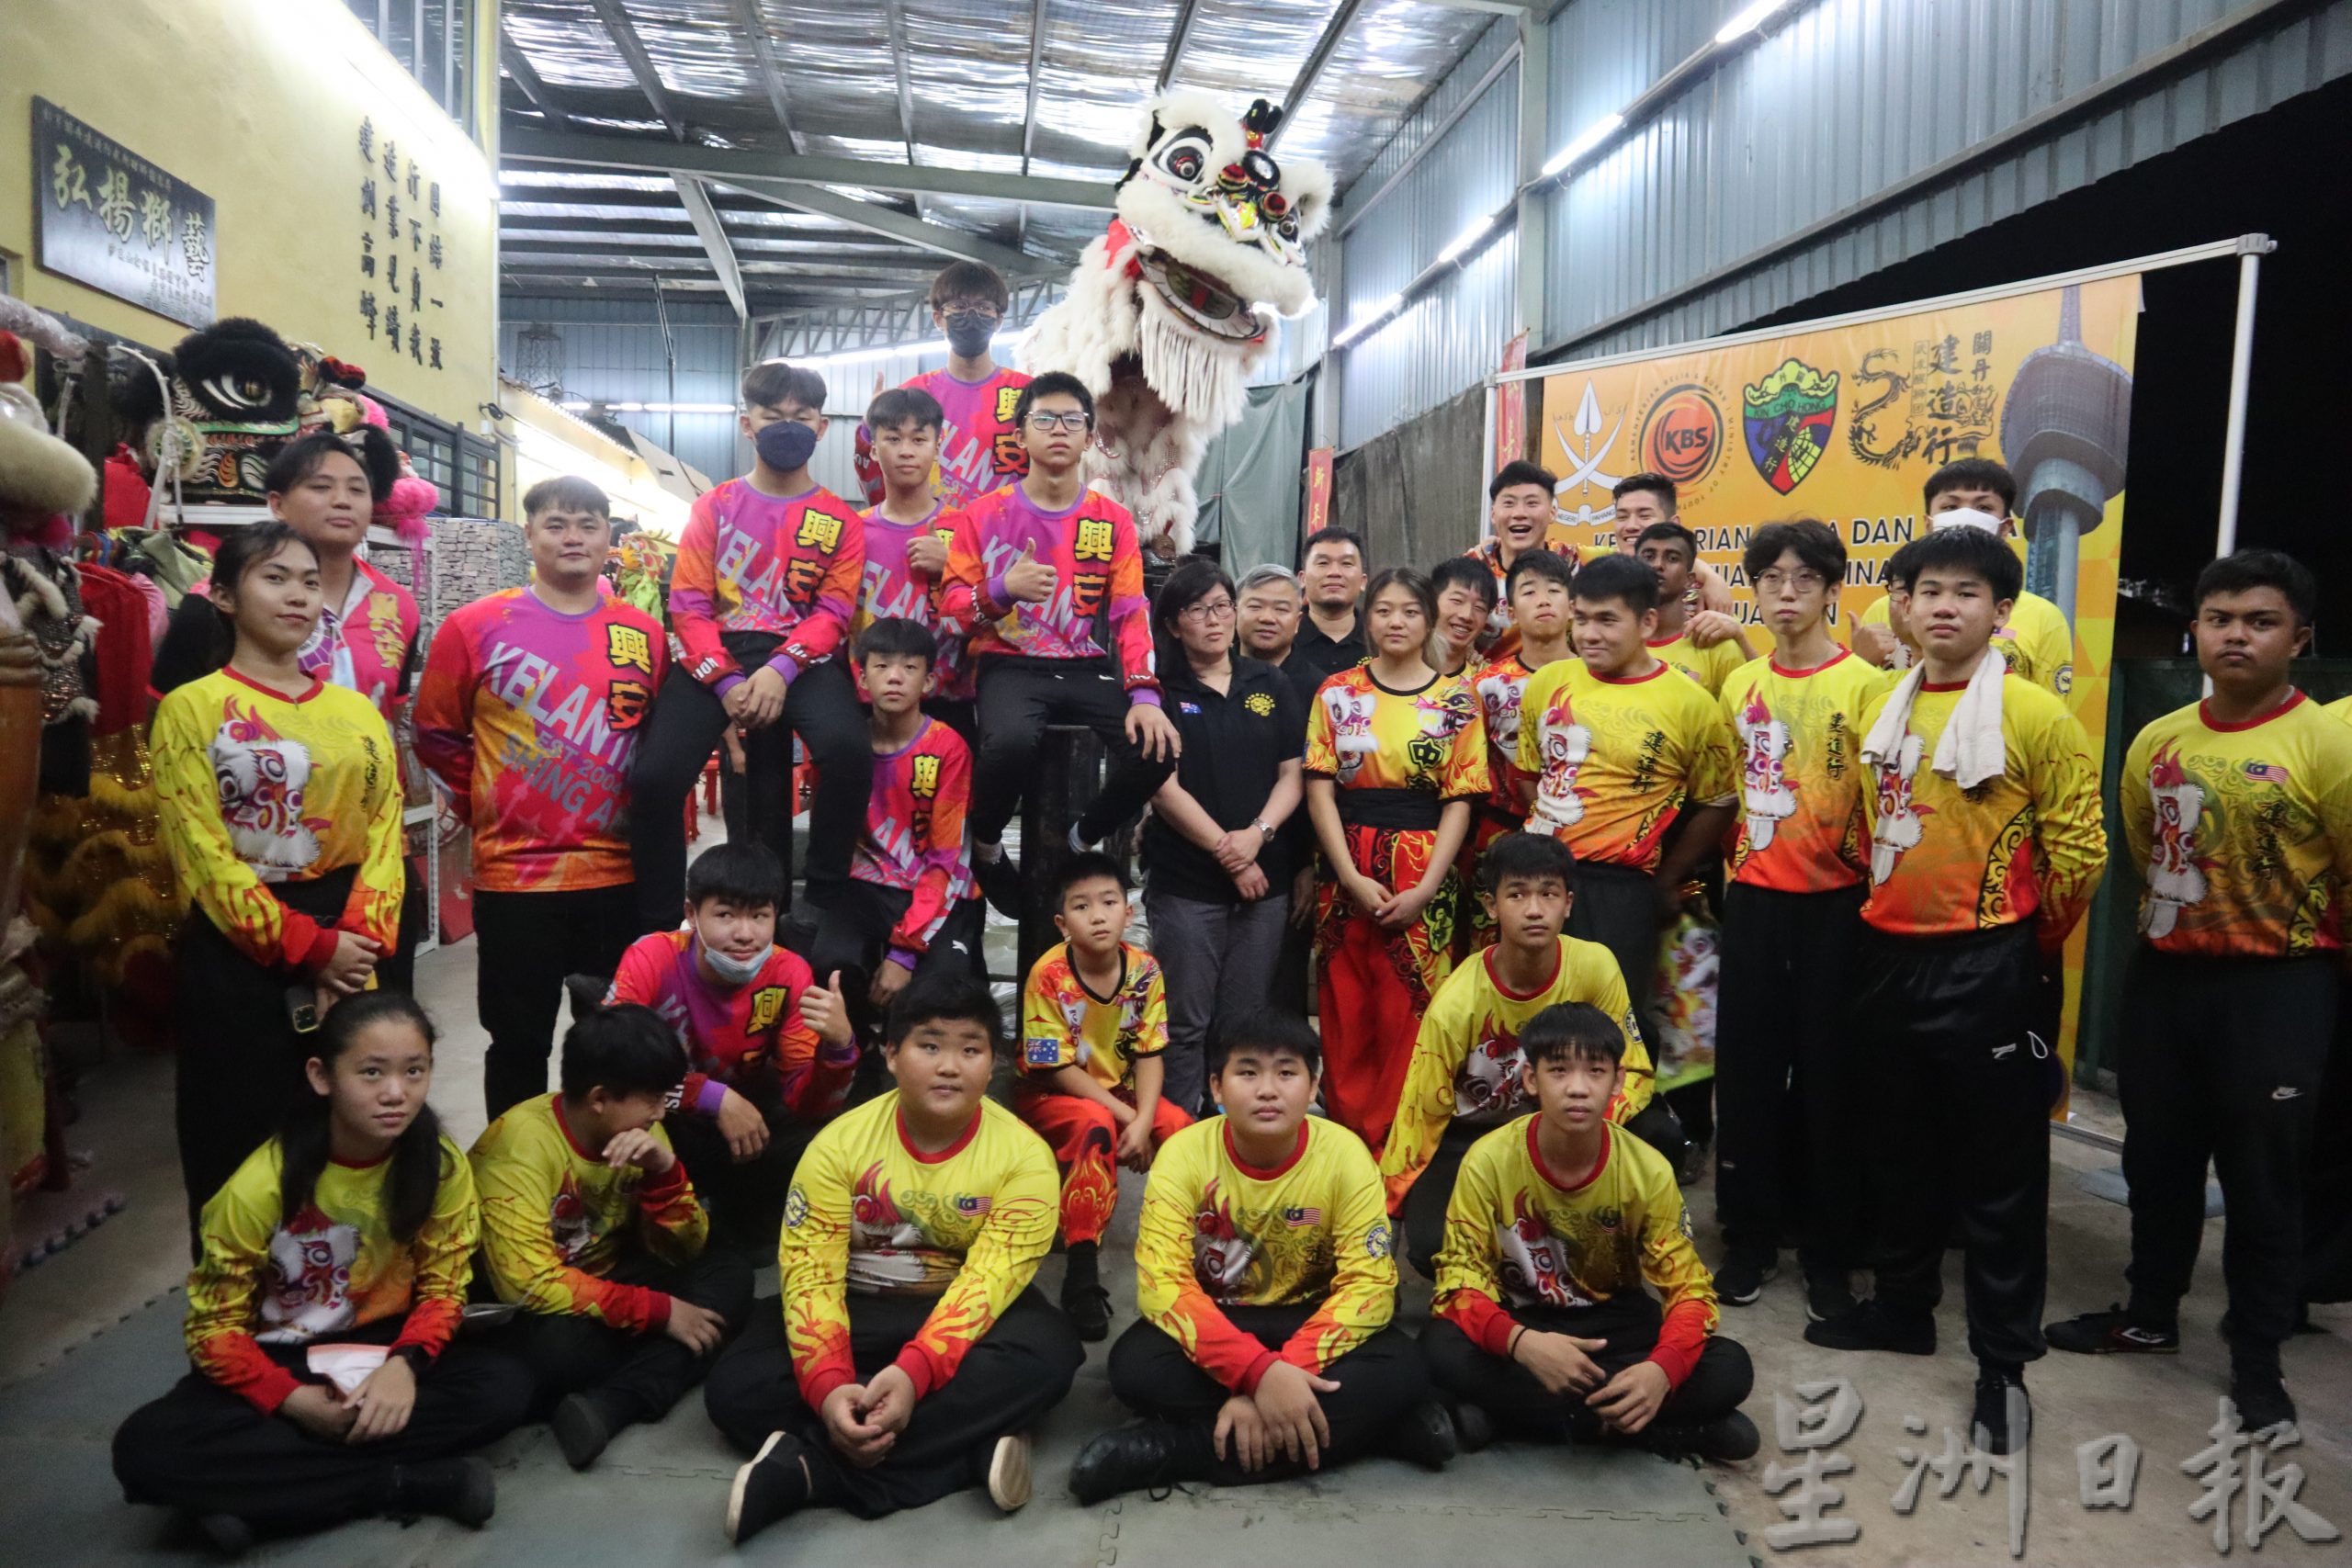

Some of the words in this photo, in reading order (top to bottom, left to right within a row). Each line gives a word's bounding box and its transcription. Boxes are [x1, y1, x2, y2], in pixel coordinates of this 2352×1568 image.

[52, 143, 210, 282] 弘揚獅藝
[1921, 333, 1962, 466] 建造行
[1664, 425, 1708, 456] KBS
[1852, 516, 1913, 545] DAN
[536, 729, 579, 763] EST
